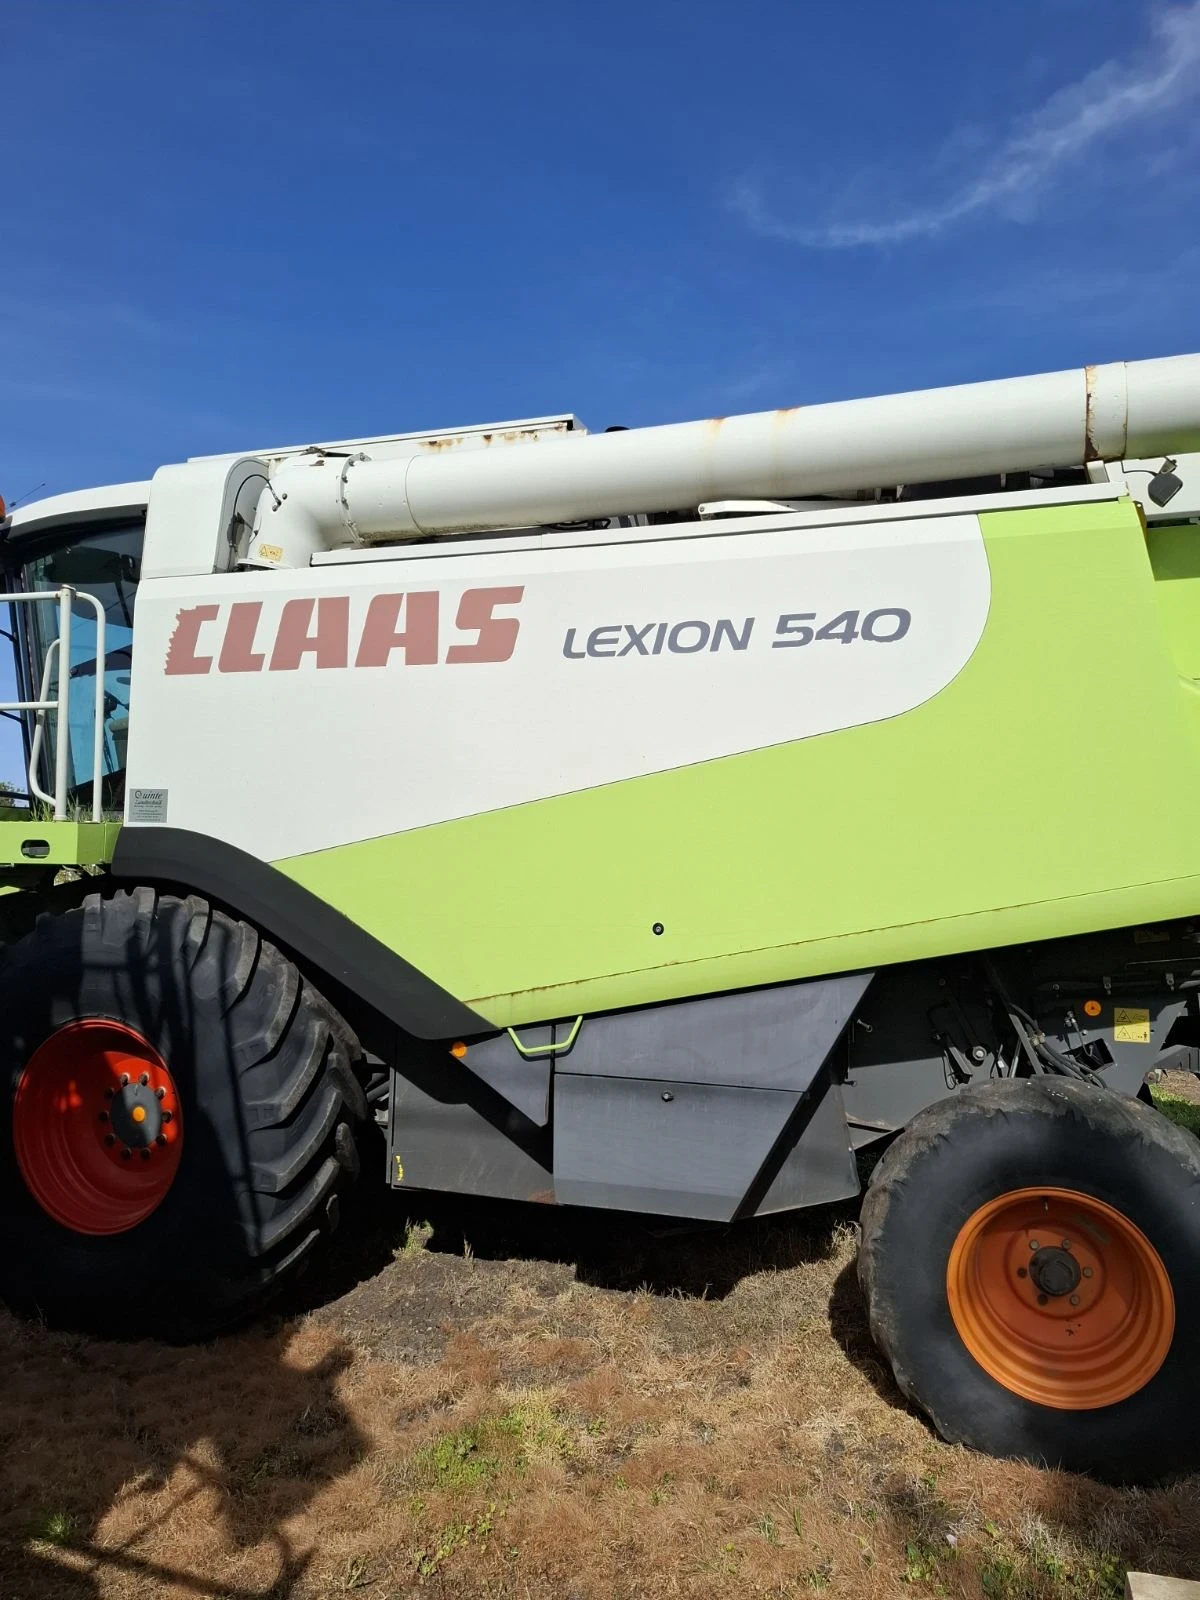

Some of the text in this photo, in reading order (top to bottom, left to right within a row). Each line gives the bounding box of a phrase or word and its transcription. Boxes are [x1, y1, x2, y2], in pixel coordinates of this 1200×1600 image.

[165, 586, 524, 675] CLAAS
[563, 607, 911, 659] LEXION 540
